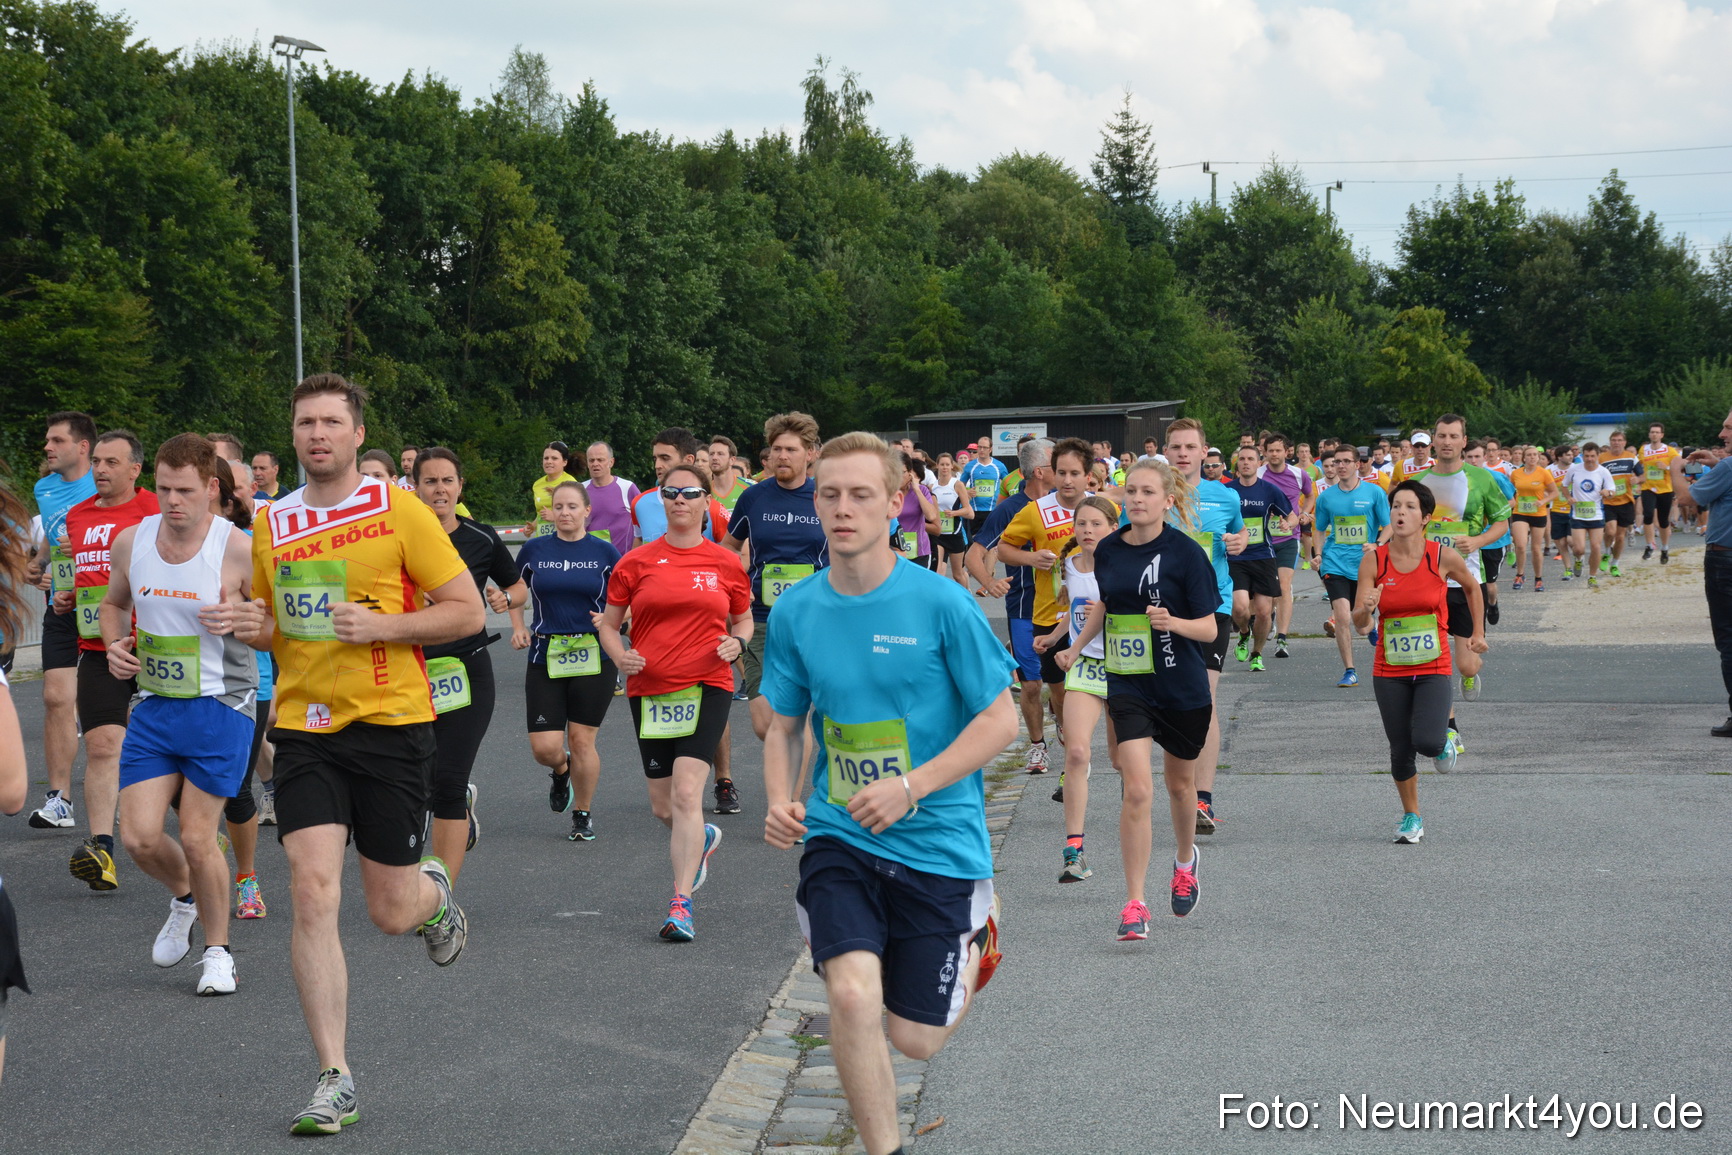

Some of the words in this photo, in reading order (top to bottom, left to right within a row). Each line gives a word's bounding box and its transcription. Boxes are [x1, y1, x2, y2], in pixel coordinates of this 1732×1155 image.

[762, 513, 787, 522] EURO
[794, 515, 820, 525] POLES
[83, 523, 116, 546] MRT
[540, 524, 555, 534] 652
[1047, 526, 1075, 541] MAX
[1338, 526, 1363, 537] 1101
[272, 540, 324, 572] MAX
[331, 521, 394, 550] BÖGL
[75, 550, 110, 565] MEIE
[538, 561, 562, 569] EURO
[571, 561, 598, 569] POLES
[153, 589, 201, 600] KLEBL
[772, 582, 792, 597] 3
[284, 592, 332, 618] 854
[881, 635, 917, 645] PFLEIDERER
[1108, 637, 1145, 657] 1159
[1390, 634, 1434, 652] 1378
[558, 649, 589, 664] 359
[873, 645, 890, 654] Mika
[146, 657, 184, 680] 553
[649, 704, 695, 722] 1588
[835, 754, 903, 786] 1095
